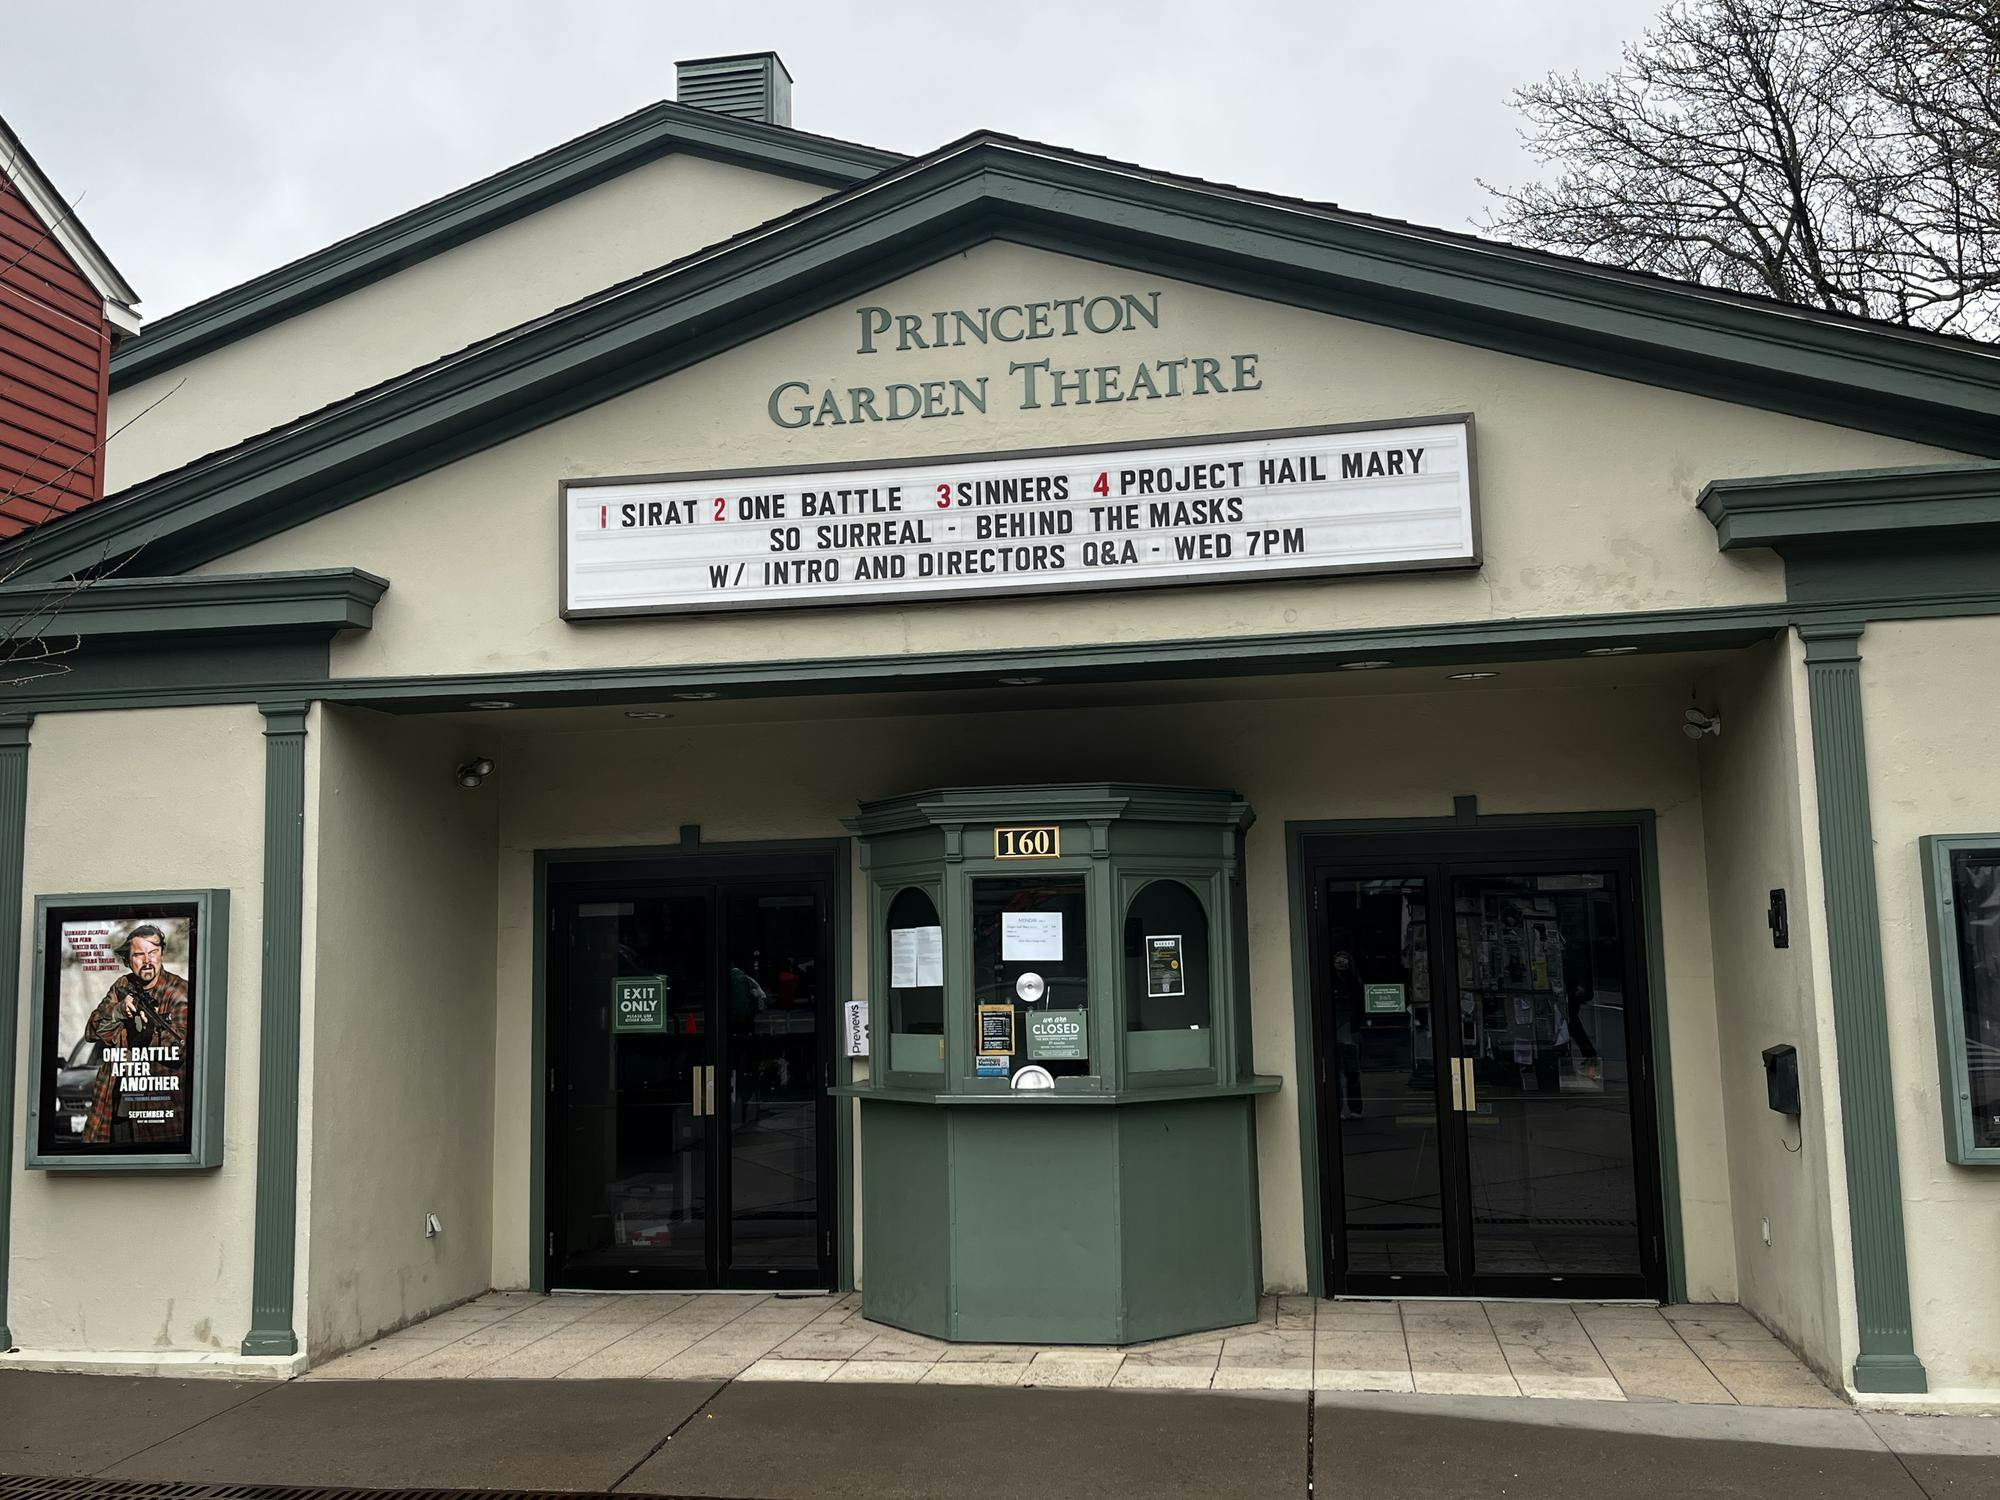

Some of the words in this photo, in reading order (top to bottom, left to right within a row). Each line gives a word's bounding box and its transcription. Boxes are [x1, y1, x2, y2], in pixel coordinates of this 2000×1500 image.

[857, 291, 1161, 354] PRINCETON
[768, 376, 989, 428] GARDEN
[1009, 353, 1263, 410] THEATRE
[622, 500, 698, 528] SIRAT
[714, 497, 726, 522] 2
[738, 494, 785, 521] ONE
[802, 486, 902, 518] BATTLE
[936, 483, 951, 510] 3
[957, 475, 1069, 508] SINNERS
[1093, 472, 1110, 497] 4
[1121, 461, 1244, 495] PROJECT
[1259, 455, 1326, 485] HAIL
[1342, 448, 1425, 479] MARY
[770, 527, 800, 552] SO
[817, 519, 931, 549] SURREAL
[976, 509, 1072, 539] BEHIND
[1089, 504, 1139, 532] THE
[1150, 496, 1244, 528] MASKS
[709, 562, 746, 589] W/
[764, 558, 840, 586] INTRO
[855, 554, 905, 581] AND
[918, 544, 1065, 578] DIRECTORS
[1083, 538, 1138, 567] Q&A
[1175, 532, 1232, 561] WED
[1247, 528, 1304, 557] 7PM
[1004, 830, 1050, 855] 160
[621, 1000, 657, 1012] ONLY
[624, 988, 655, 999] EXIT
[851, 1004, 861, 1053] Previews
[1032, 1023, 1079, 1034] CLOSED
[103, 1048, 128, 1062] ONE
[131, 1046, 180, 1061] BATTLE
[112, 1062, 151, 1076] AFTER
[119, 1076, 179, 1091] ANOTHER
